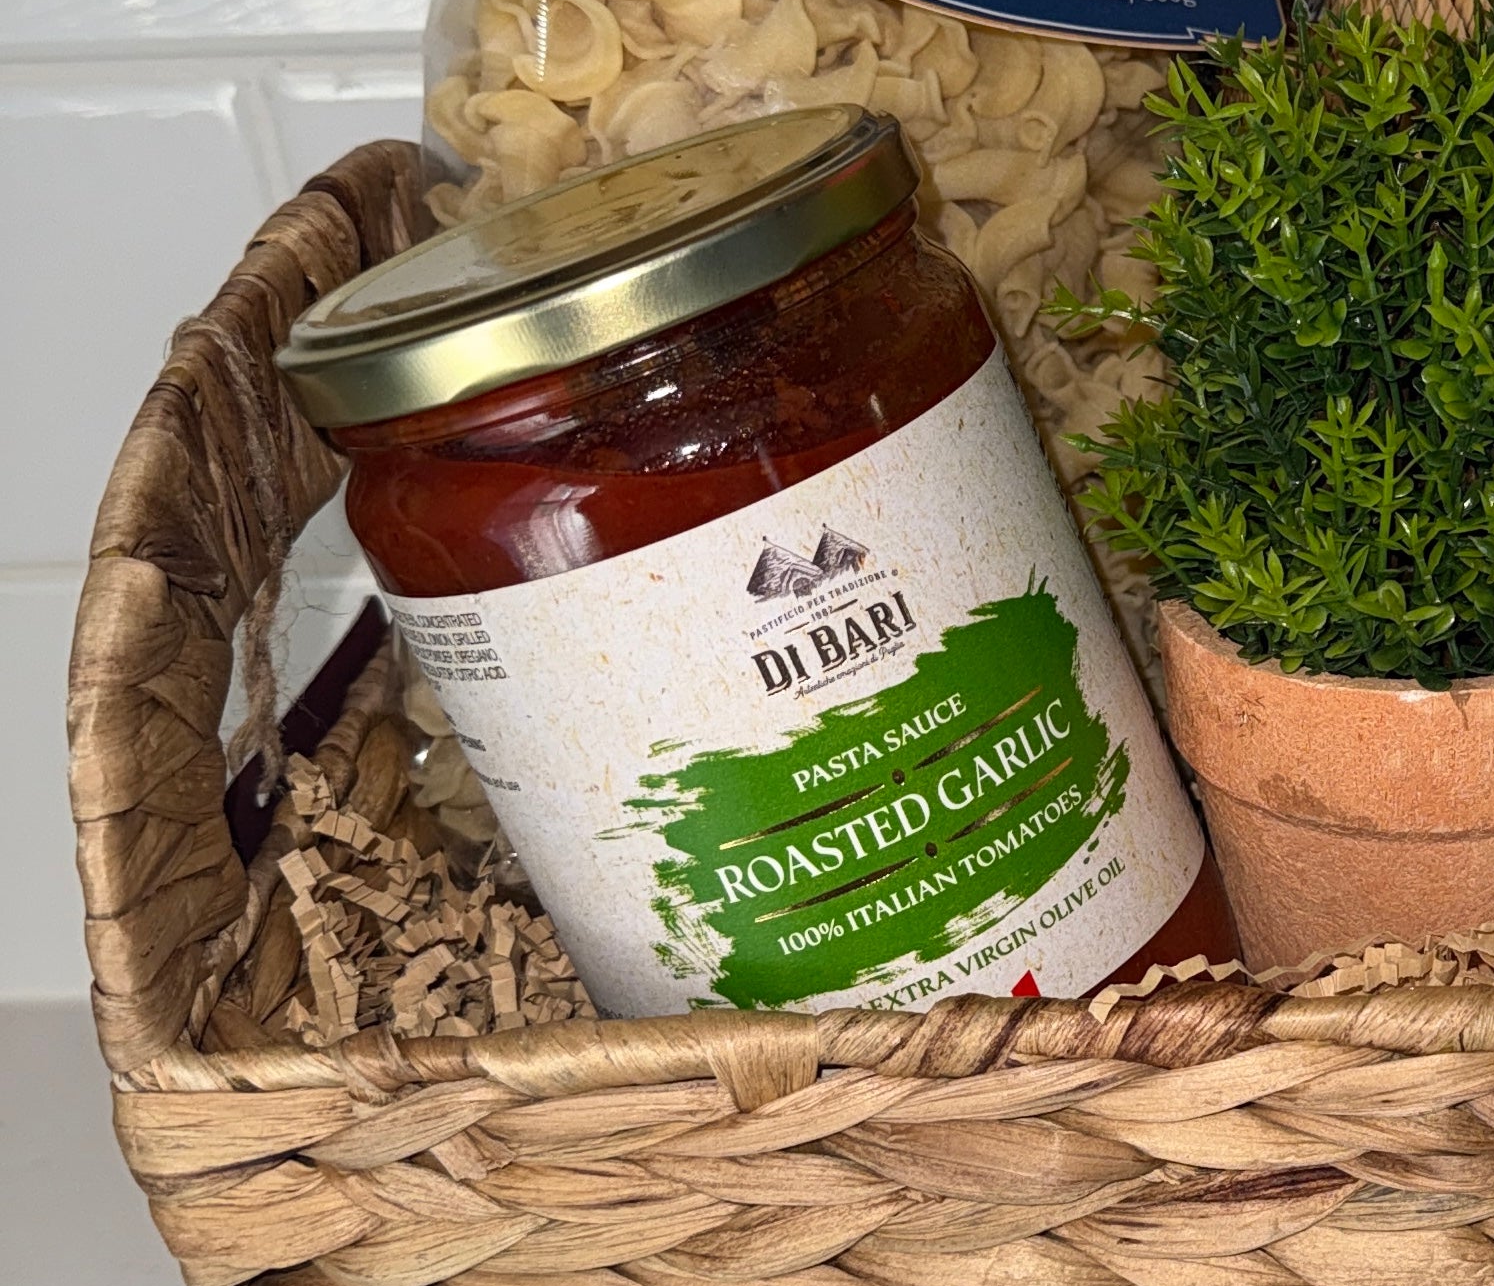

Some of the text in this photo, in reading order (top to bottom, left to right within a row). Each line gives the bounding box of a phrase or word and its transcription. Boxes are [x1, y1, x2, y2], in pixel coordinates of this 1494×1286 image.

[750, 569, 888, 641] PASTIFICIO PER TRADIZIONE
[750, 590, 917, 697] DI BARI
[713, 697, 1072, 906] ROASTED GARLIC
[791, 691, 968, 794] PASTA SAUCE
[776, 783, 1084, 957] 100% ITALIAN TOMATOES
[868, 855, 1127, 1011] EXTRA VIRGIN OLIVE OIL
